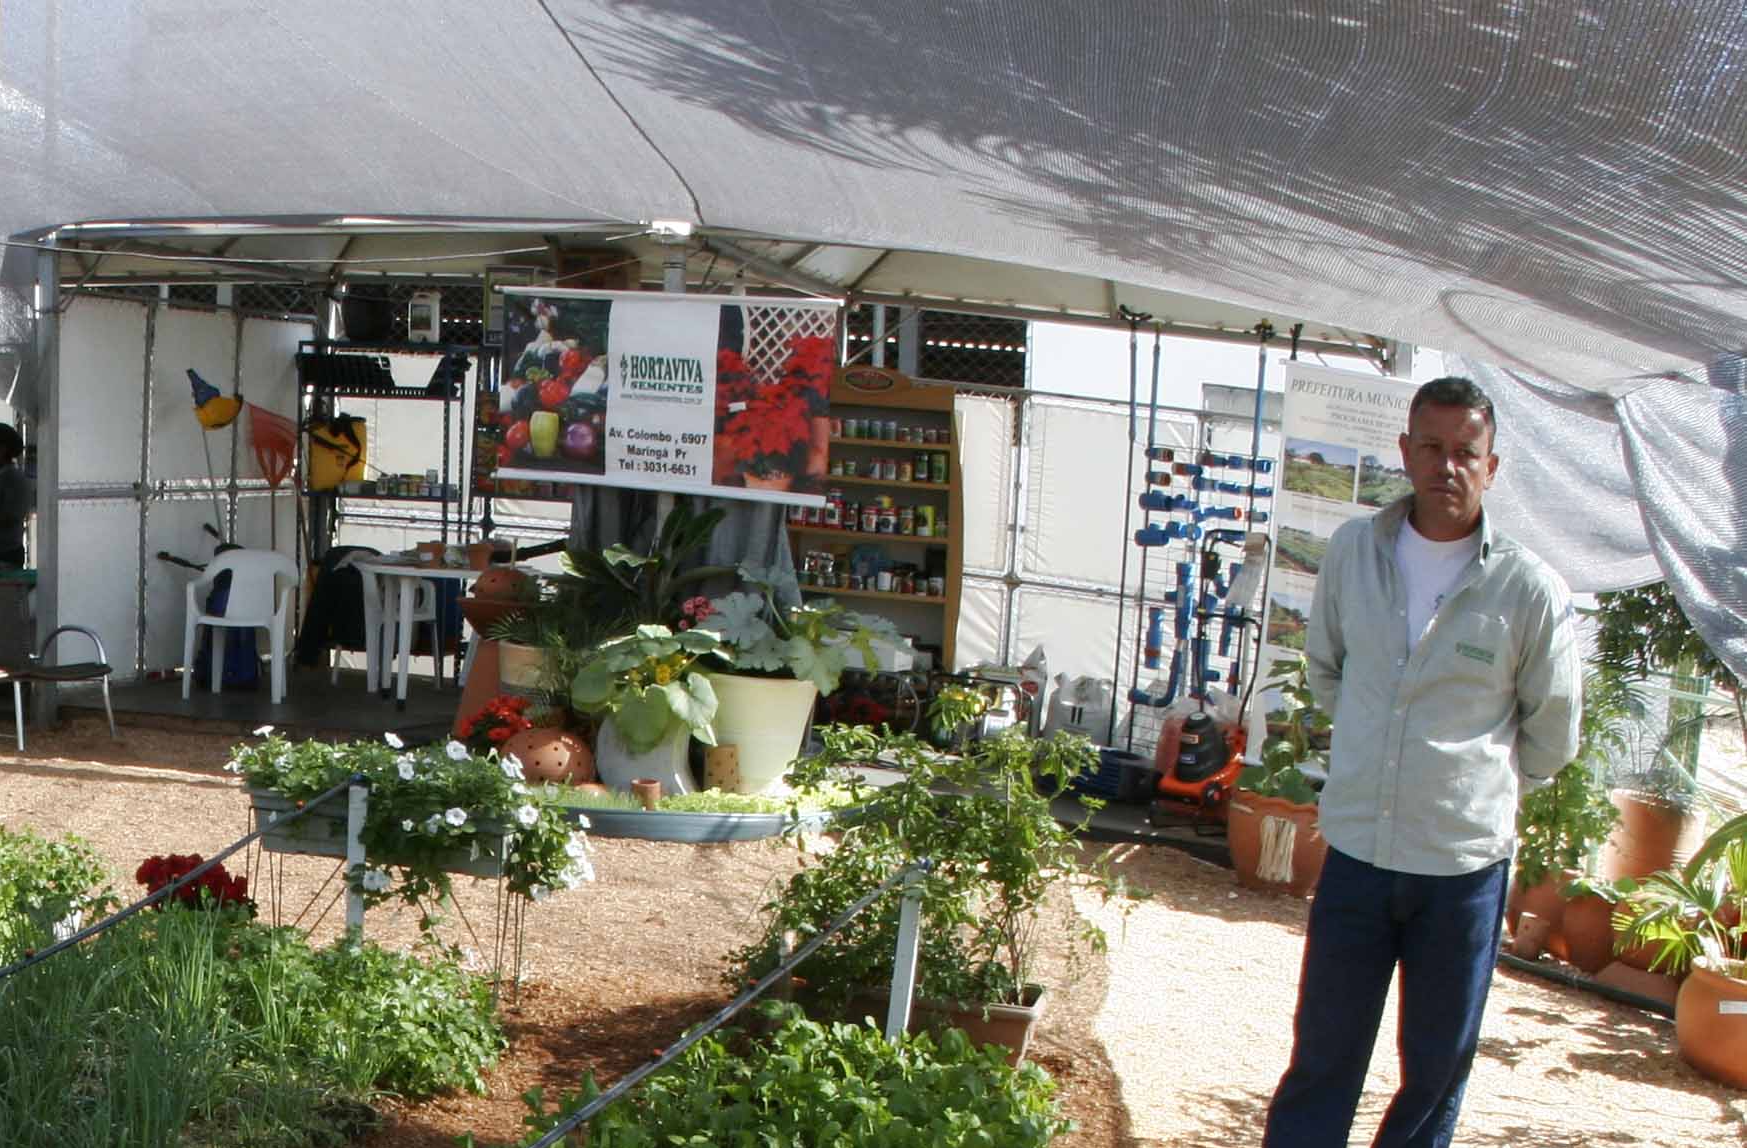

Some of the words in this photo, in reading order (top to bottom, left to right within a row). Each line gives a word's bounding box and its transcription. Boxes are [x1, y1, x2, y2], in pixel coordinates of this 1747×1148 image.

[630, 355, 703, 383] HORTAVIVA
[630, 381, 703, 394] SEMENTES
[1291, 379, 1366, 405] PREFEITURA
[609, 427, 623, 439] Av.
[627, 428, 672, 443] Colombo
[681, 432, 708, 445] 6907
[675, 447, 687, 459] Pr
[643, 461, 697, 476] 3031-6631
